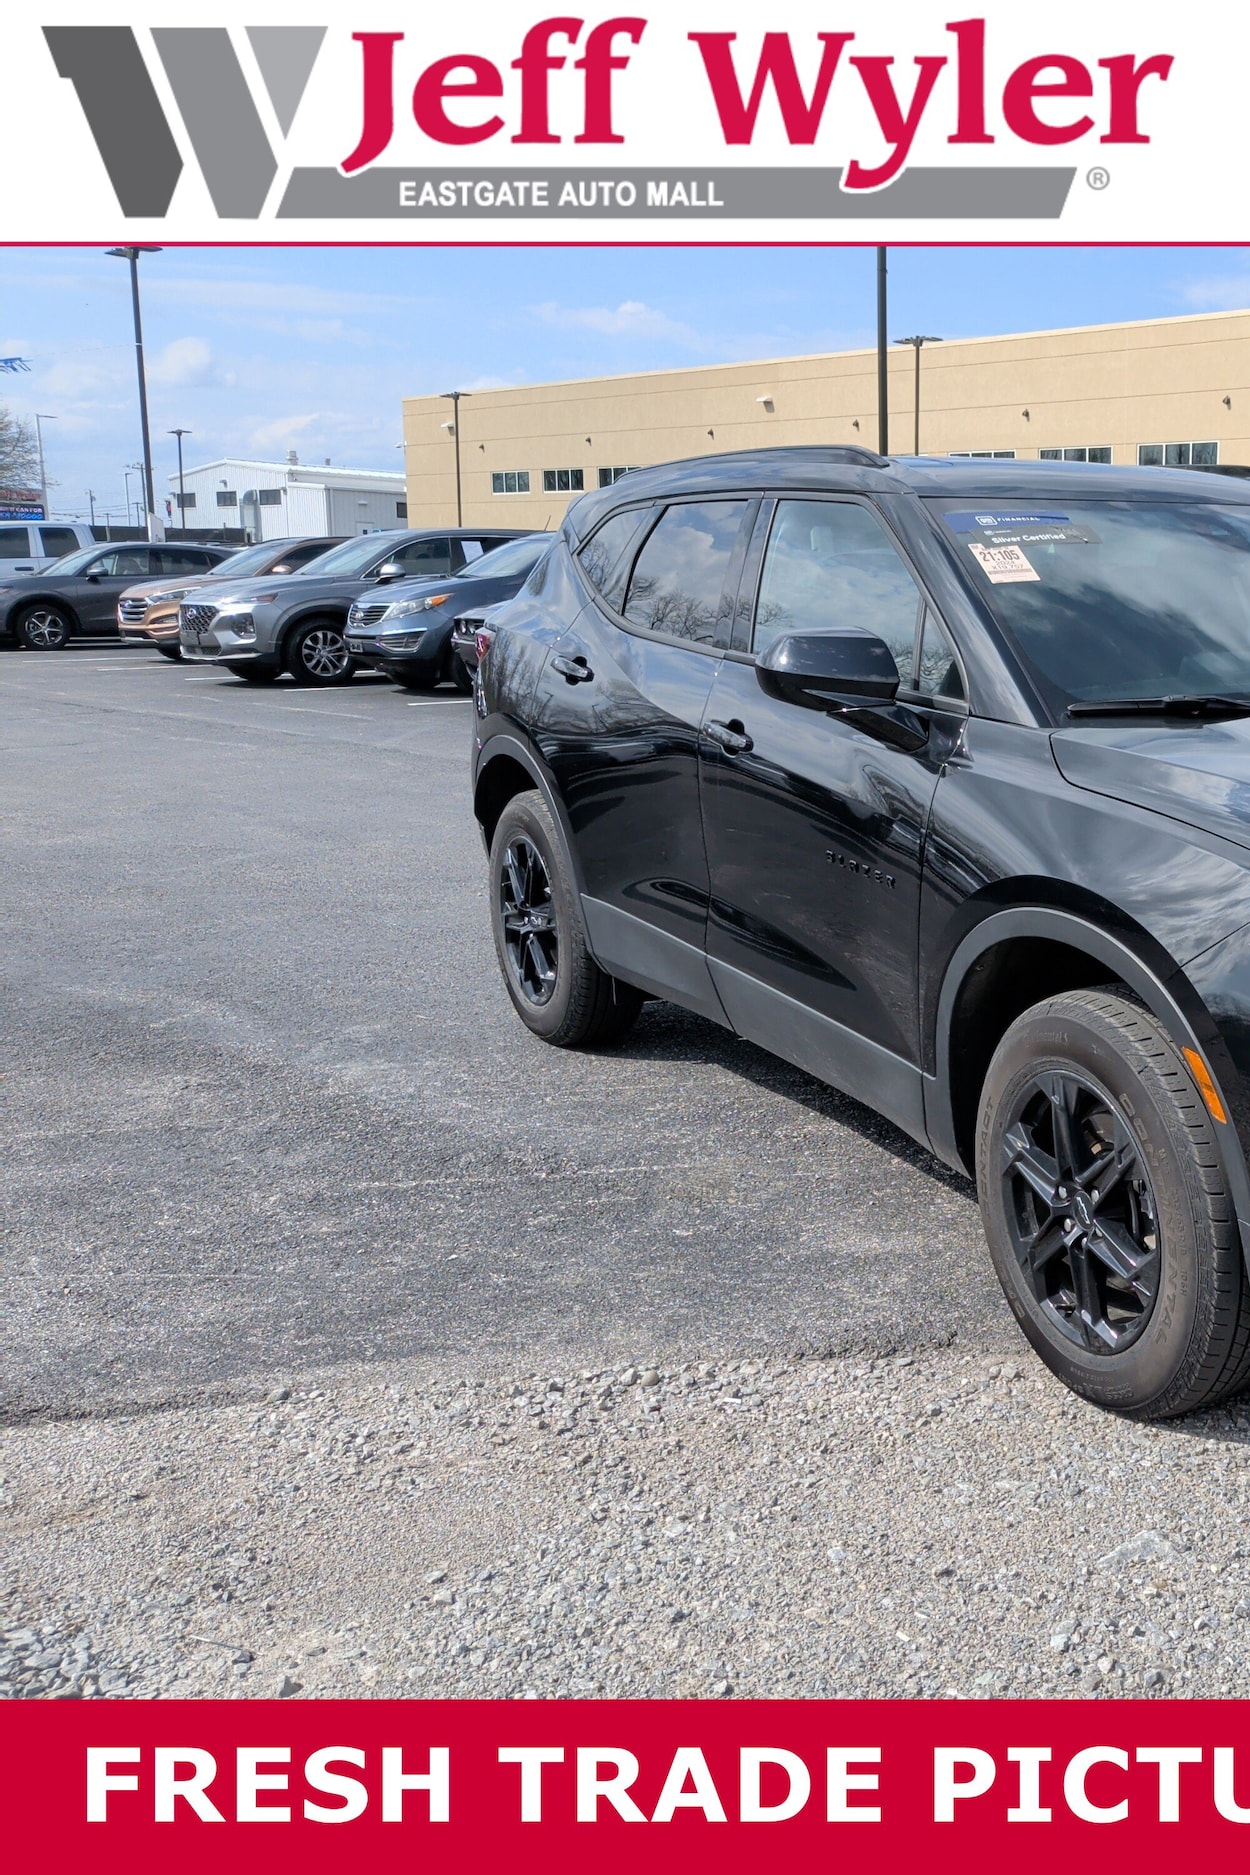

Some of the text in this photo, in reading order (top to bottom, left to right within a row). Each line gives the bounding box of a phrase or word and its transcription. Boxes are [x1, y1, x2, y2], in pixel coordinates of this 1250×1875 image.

[991, 536, 1021, 544] Silver
[1022, 532, 1066, 541] Certified
[979, 549, 1020, 562] 21:105
[825, 849, 897, 889] BLAZER
